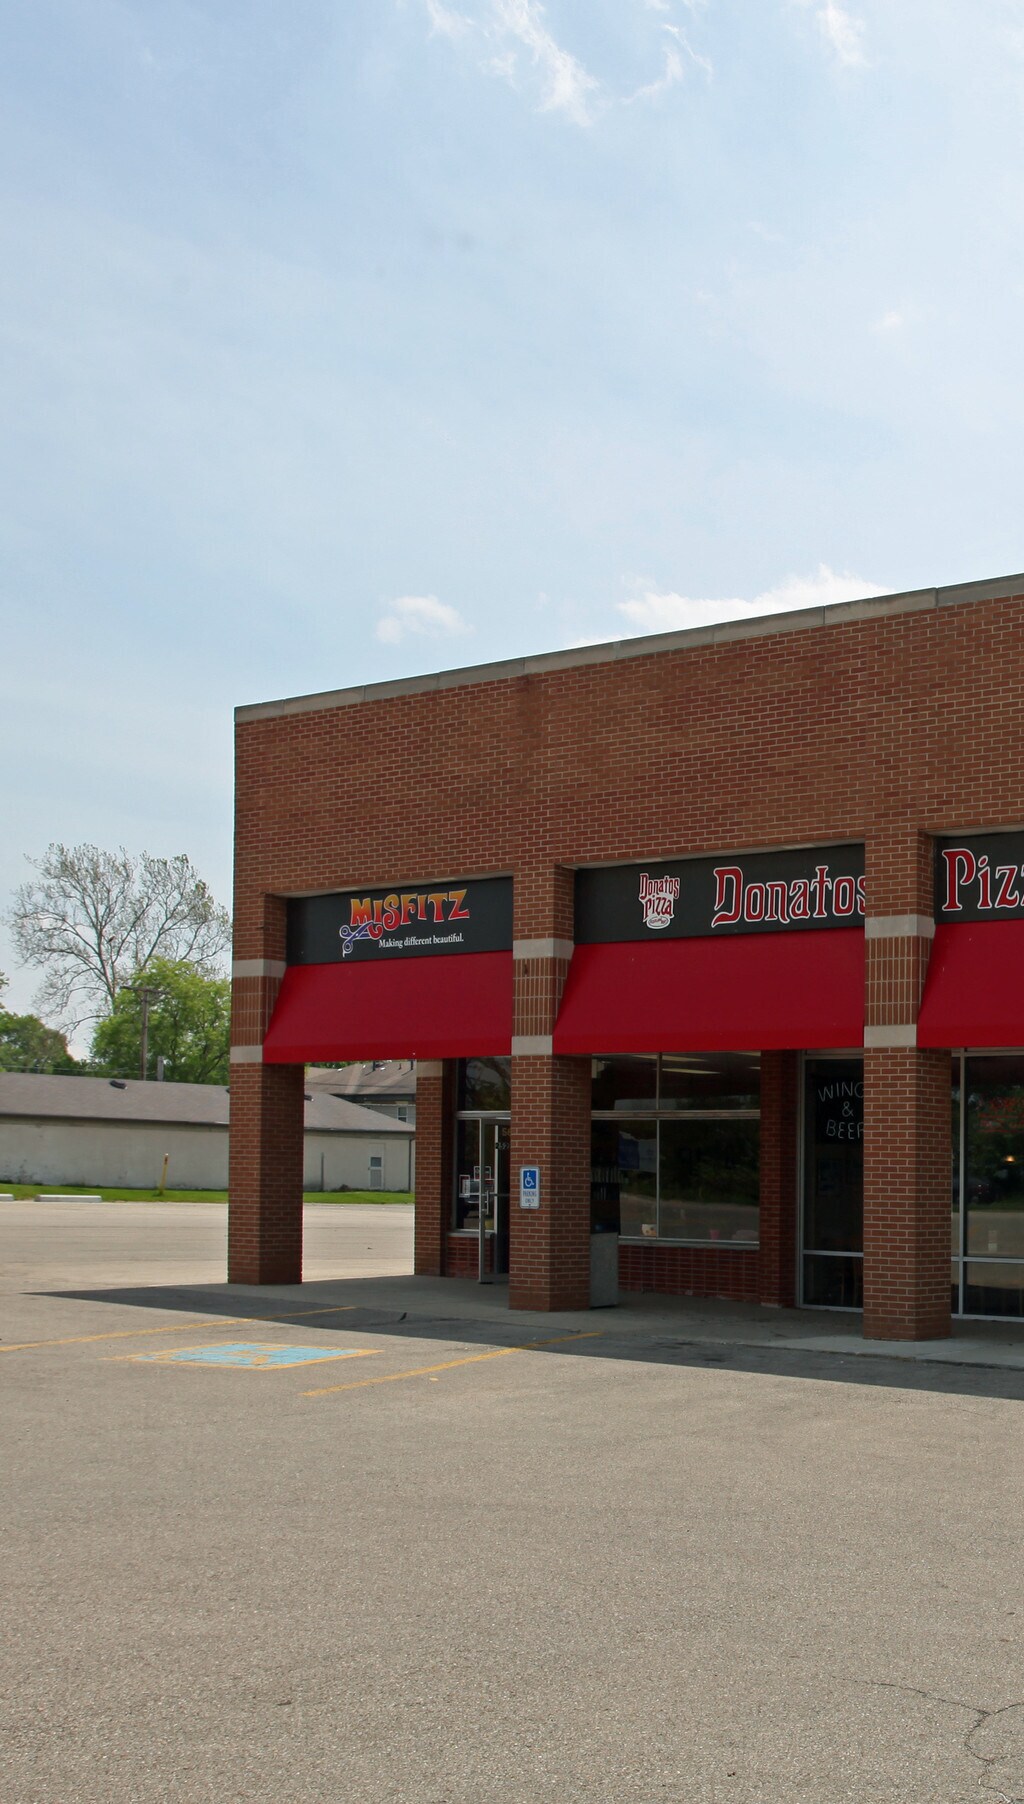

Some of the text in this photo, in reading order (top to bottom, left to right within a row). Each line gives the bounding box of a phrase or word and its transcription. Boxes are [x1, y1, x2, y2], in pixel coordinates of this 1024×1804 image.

[638, 873, 680, 900] Donatos
[349, 889, 470, 936] MISFITZ
[378, 933, 464, 949] Making different beautiful.
[842, 1101, 854, 1117] &
